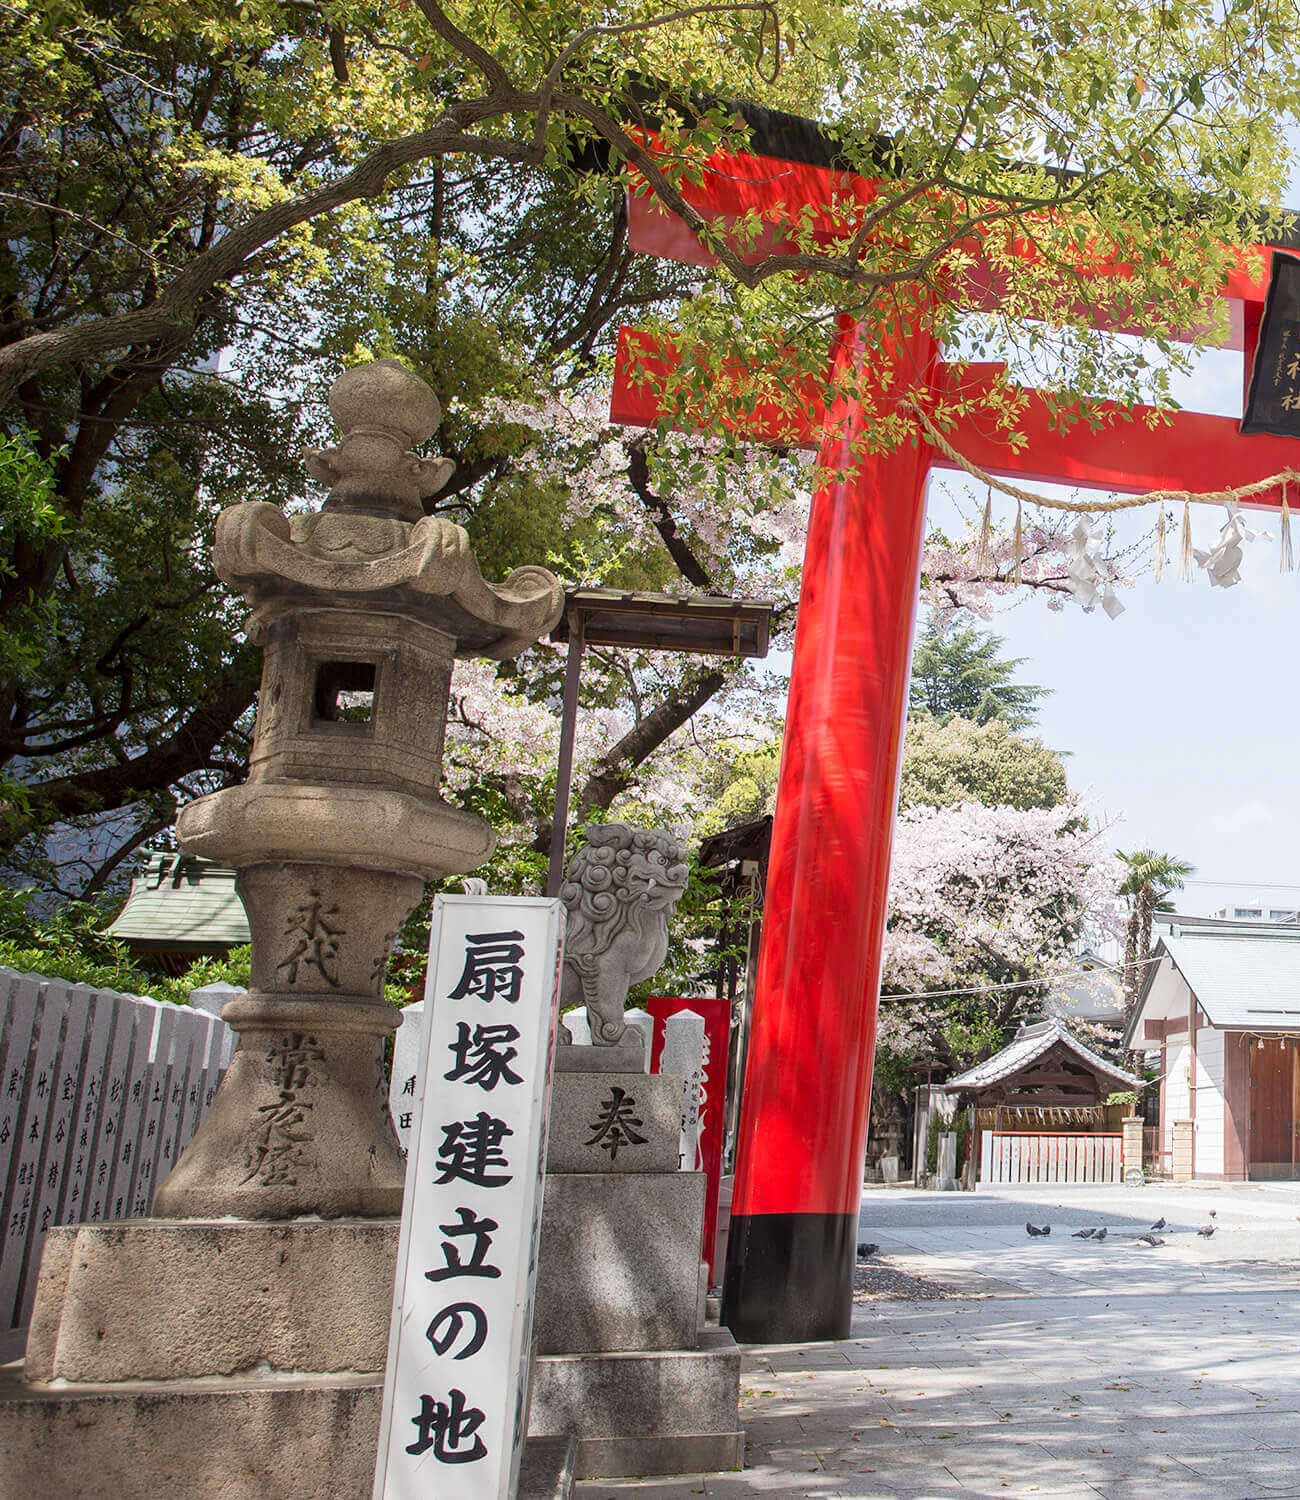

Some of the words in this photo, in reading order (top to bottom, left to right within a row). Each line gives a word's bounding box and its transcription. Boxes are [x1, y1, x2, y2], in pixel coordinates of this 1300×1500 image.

[277, 888, 346, 988] 永代
[583, 1087, 650, 1160] 奉
[405, 930, 525, 1465] 扇塚建立の地
